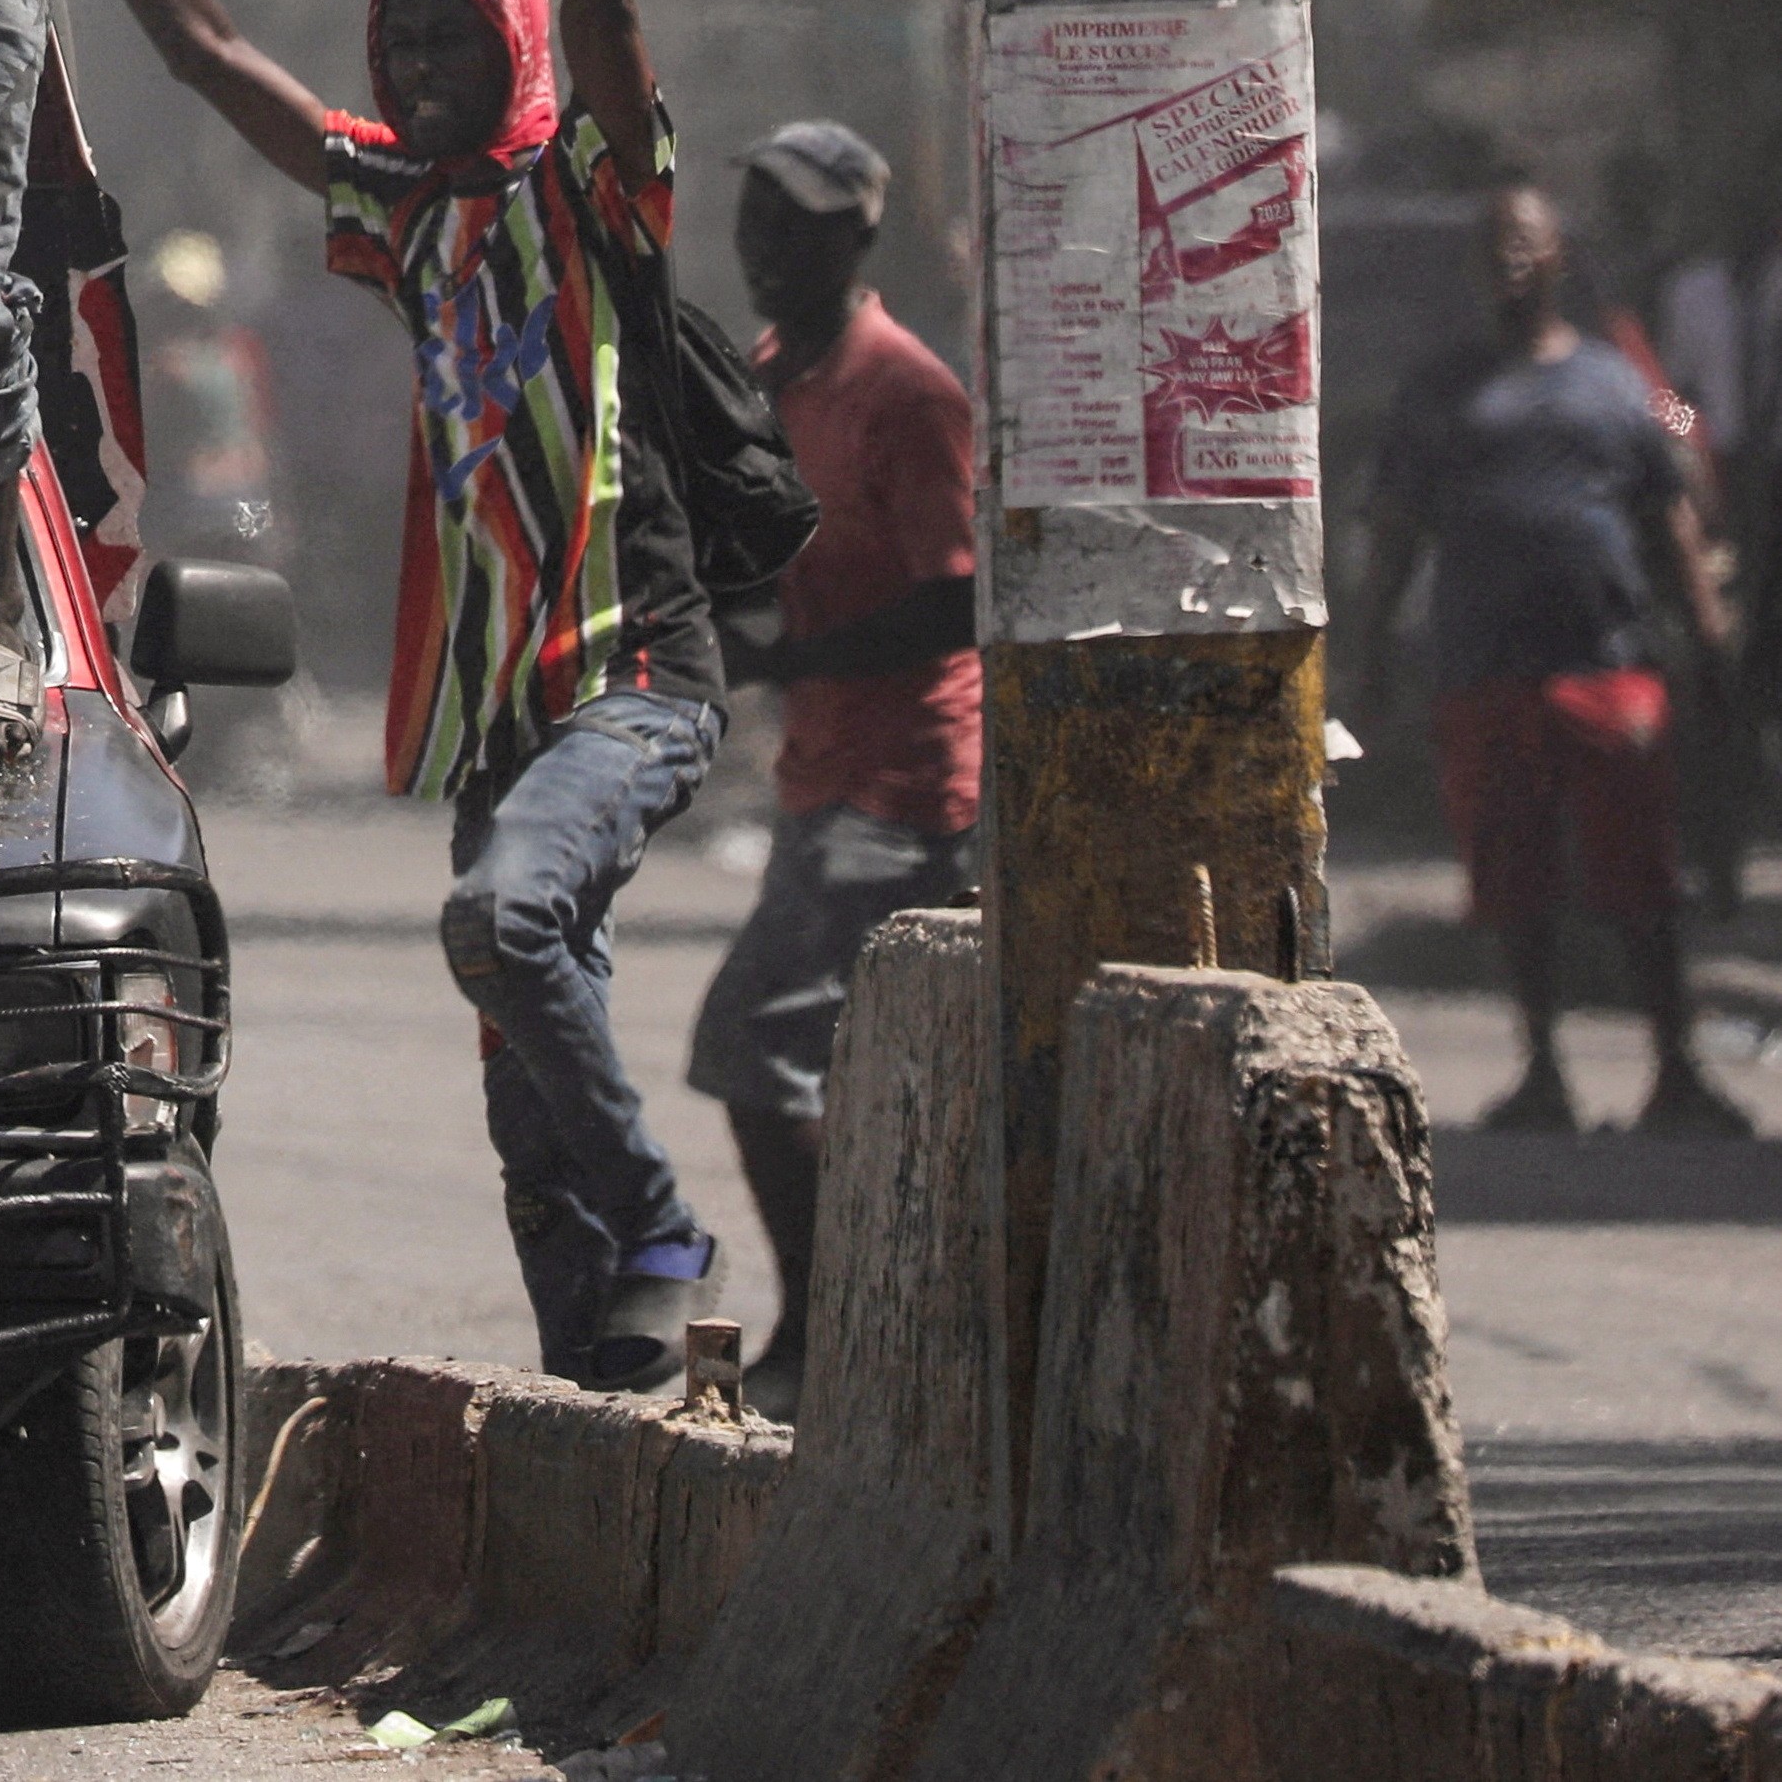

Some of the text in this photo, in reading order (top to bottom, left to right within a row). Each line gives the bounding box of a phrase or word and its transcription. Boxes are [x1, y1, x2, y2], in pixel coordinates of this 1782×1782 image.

[1054, 45, 1083, 61] LE
[1151, 60, 1287, 139] SPECIAL
[1164, 84, 1286, 154] IMPRESSION
[1154, 96, 1301, 184] CALENDRIER
[1255, 203, 1291, 222] 2023
[1195, 449, 1239, 470] 4X6
